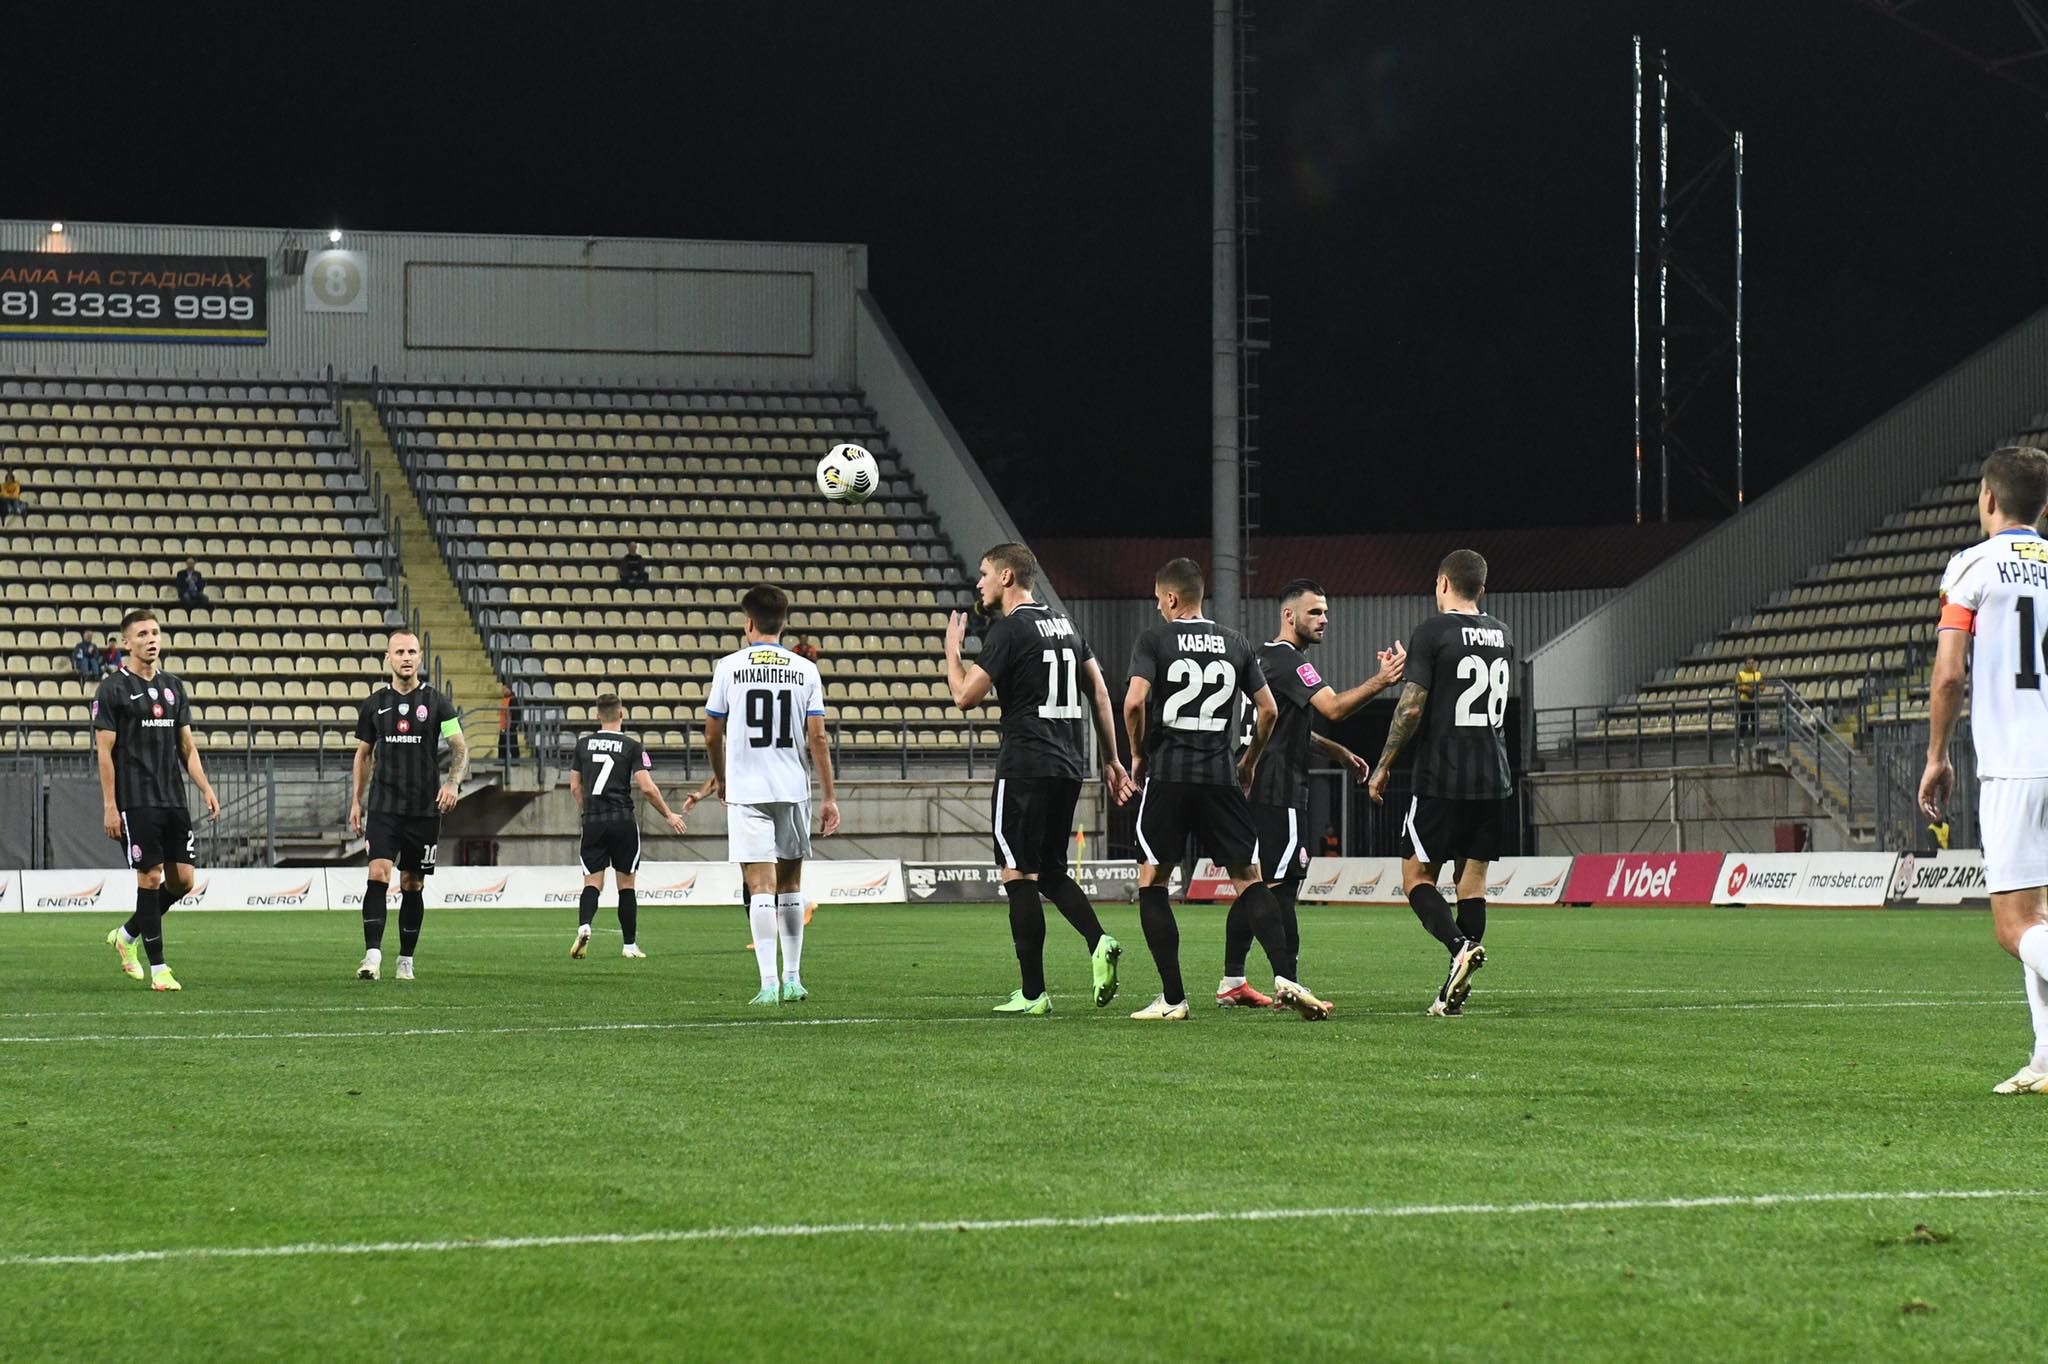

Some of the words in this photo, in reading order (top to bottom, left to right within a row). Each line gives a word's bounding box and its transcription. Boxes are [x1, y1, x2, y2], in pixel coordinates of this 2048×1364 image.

[67, 269, 102, 285] НА
[109, 270, 255, 289] СТАДІОНАХ
[325, 265, 346, 295] 8
[51, 292, 161, 319] 3333
[174, 295, 254, 320] 999
[2014, 595, 2048, 690] 1
[1038, 648, 1082, 719] 11
[1455, 654, 1510, 729] 28
[1162, 657, 1236, 732] 22
[141, 719, 175, 728] MARSBET
[746, 688, 793, 749] 91
[385, 735, 422, 744] MARSBET
[592, 753, 615, 796] 7
[420, 844, 437, 864] 10
[937, 869, 981, 881] ANVER
[1746, 872, 1797, 888] MARSBET
[1808, 872, 1884, 888] marsbet.com
[246, 895, 308, 906] ENERGY
[444, 893, 503, 904] ENERGY
[830, 887, 888, 897] ENERGY
[1523, 886, 1554, 897] ENERGY
[37, 897, 99, 908] ENERGY
